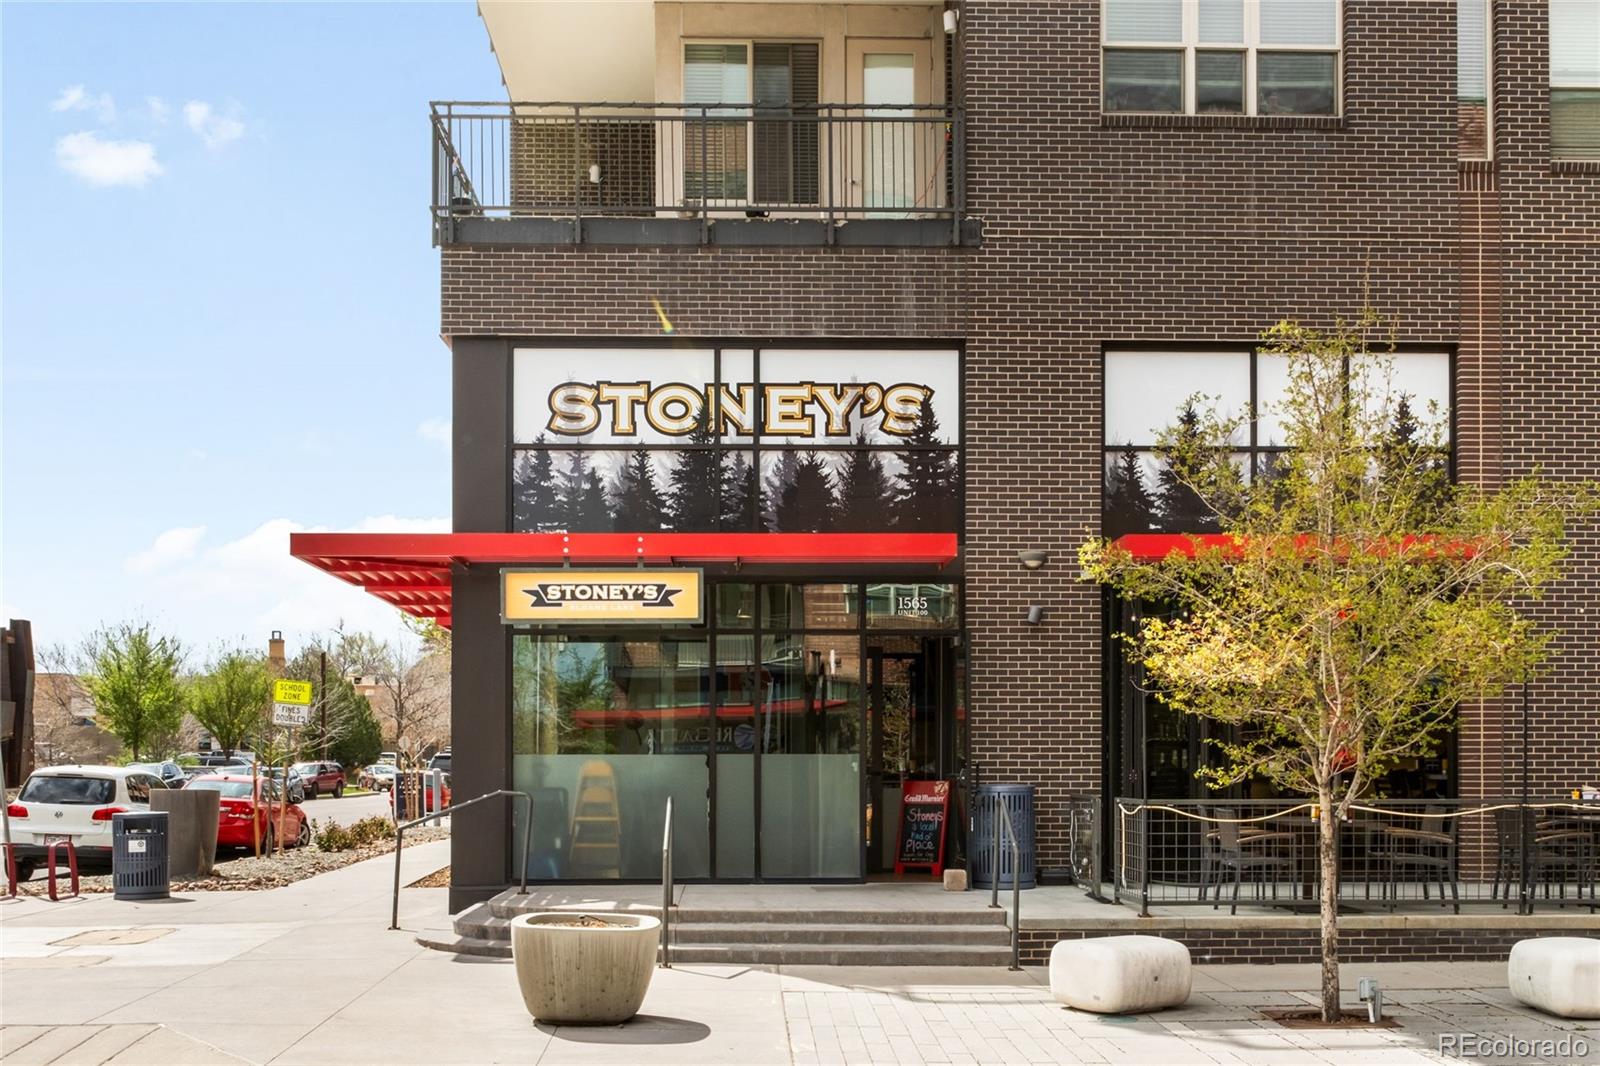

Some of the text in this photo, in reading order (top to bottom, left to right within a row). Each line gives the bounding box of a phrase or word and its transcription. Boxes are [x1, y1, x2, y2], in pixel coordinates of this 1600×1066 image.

[547, 381, 934, 437] STONEY'S
[546, 584, 659, 600] STONEY'S
[898, 597, 928, 609] 1565
[280, 683, 306, 692] SCHOOL
[283, 692, 301, 700] ZONE
[281, 705, 300, 714] FINES
